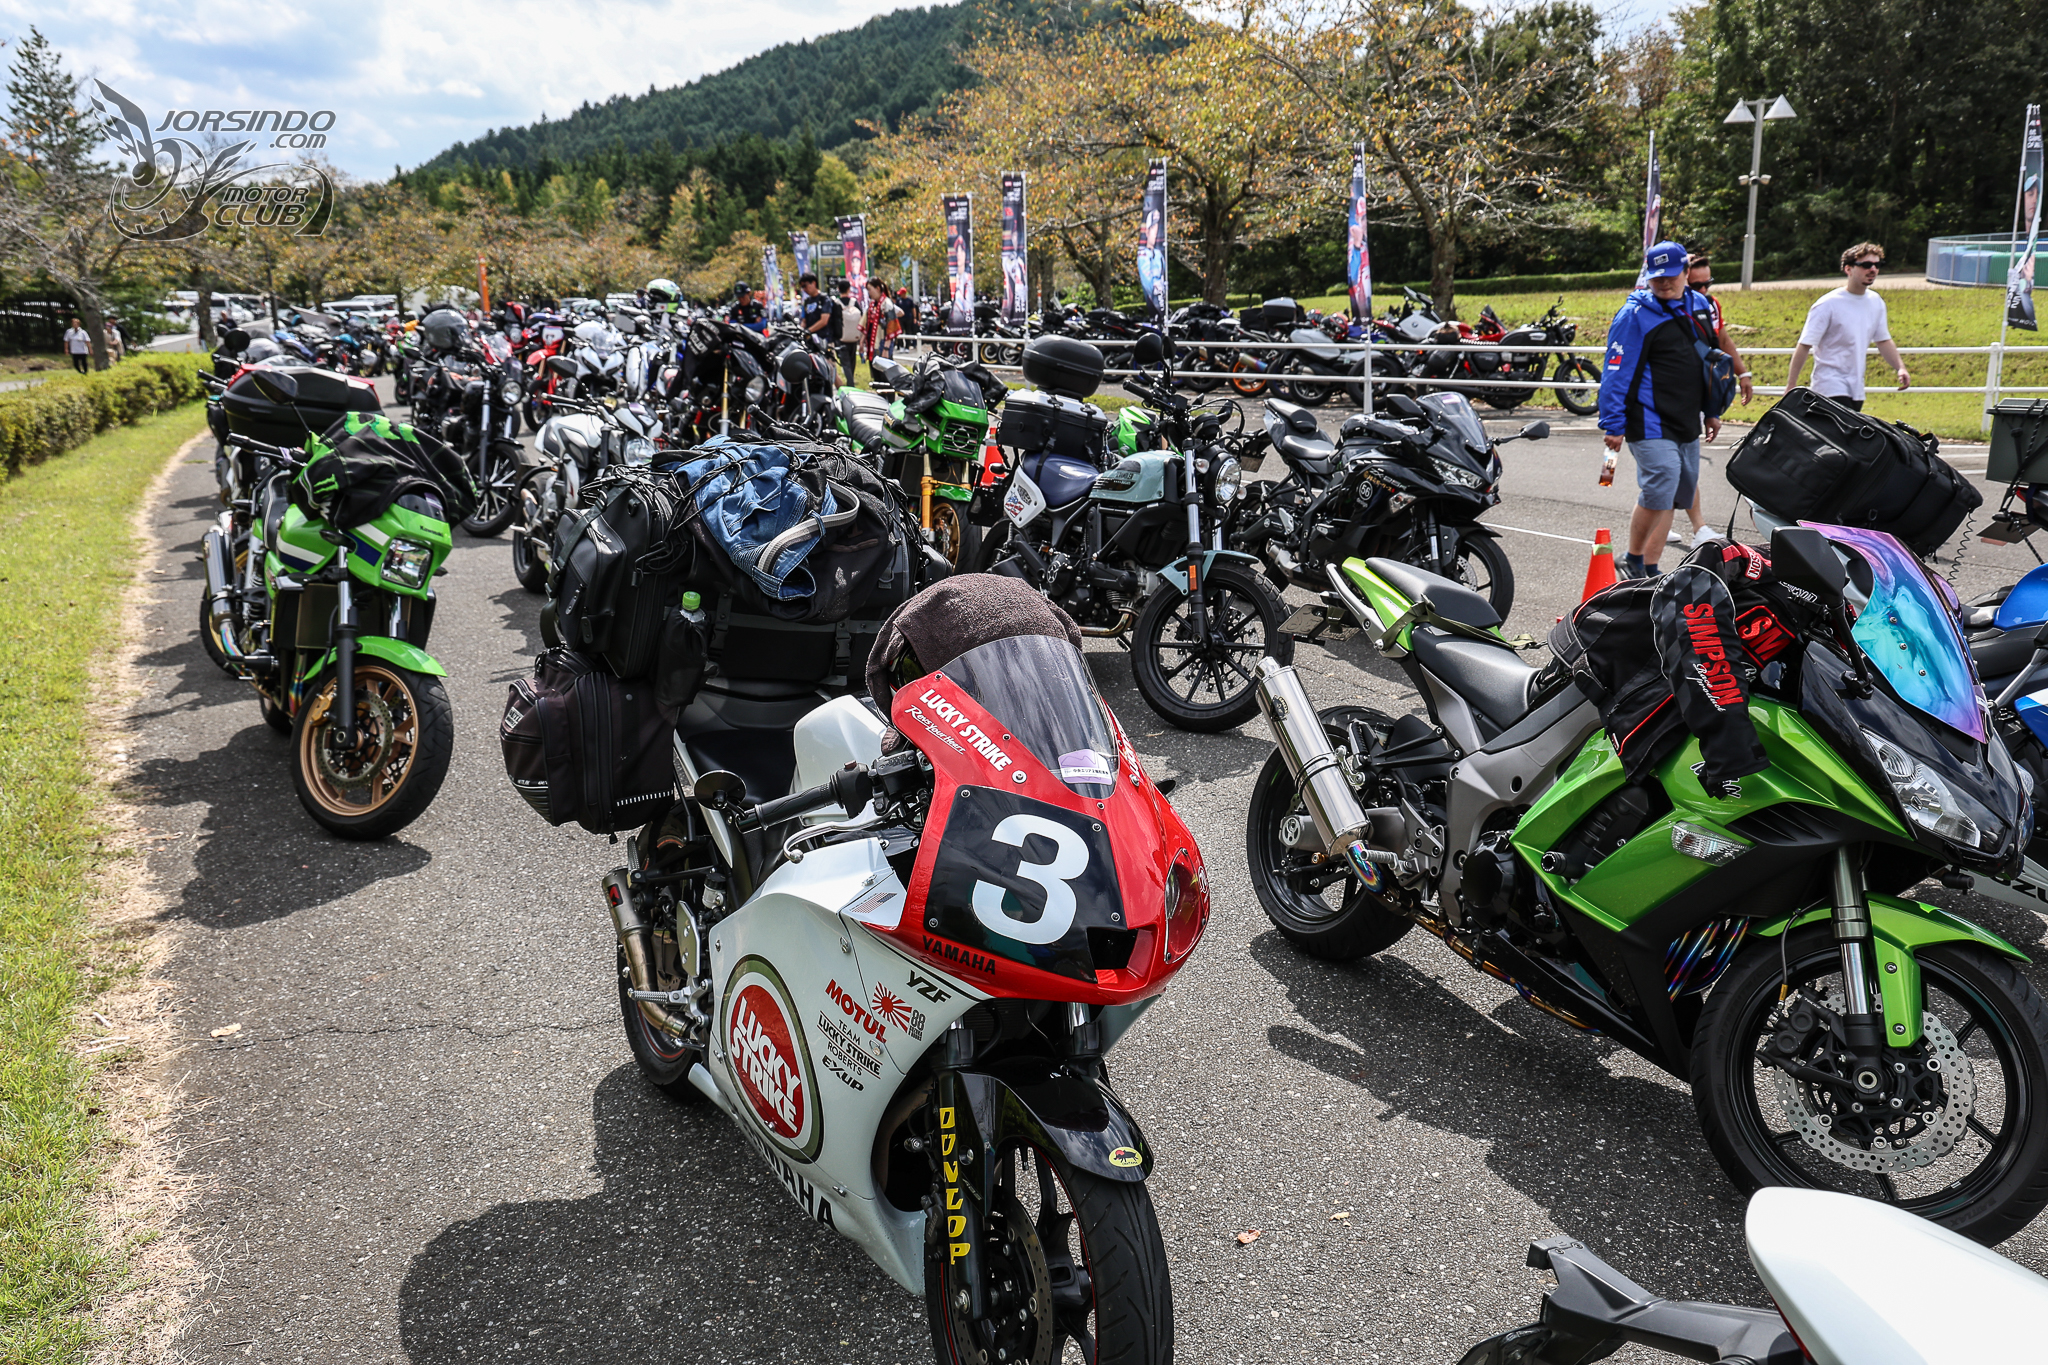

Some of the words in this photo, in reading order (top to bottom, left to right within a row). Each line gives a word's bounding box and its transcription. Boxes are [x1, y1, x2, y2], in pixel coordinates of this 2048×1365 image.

[1361, 484, 1371, 497] 56
[1683, 603, 1744, 706] SIMPSON
[1692, 663, 1714, 688] Race
[904, 704, 933, 728] Revs
[943, 735, 967, 755] Heart
[918, 688, 970, 727] LUCKY
[961, 724, 1013, 772] STRIKE
[972, 813, 1090, 944] 3
[922, 934, 997, 976] YAMAHA
[825, 978, 887, 1043] MOTUL
[906, 969, 952, 1003] YZF
[736, 996, 801, 1095] LUCKY
[818, 1014, 846, 1048] LUCKY
[846, 1043, 880, 1076] STRIKE
[838, 1019, 862, 1046] TEAM
[911, 1009, 926, 1031] 88
[731, 1026, 798, 1133] STRIKE
[822, 1054, 864, 1092] EXUP
[827, 1041, 863, 1076] ROBERTS
[940, 1107, 971, 1265] DUNLOP
